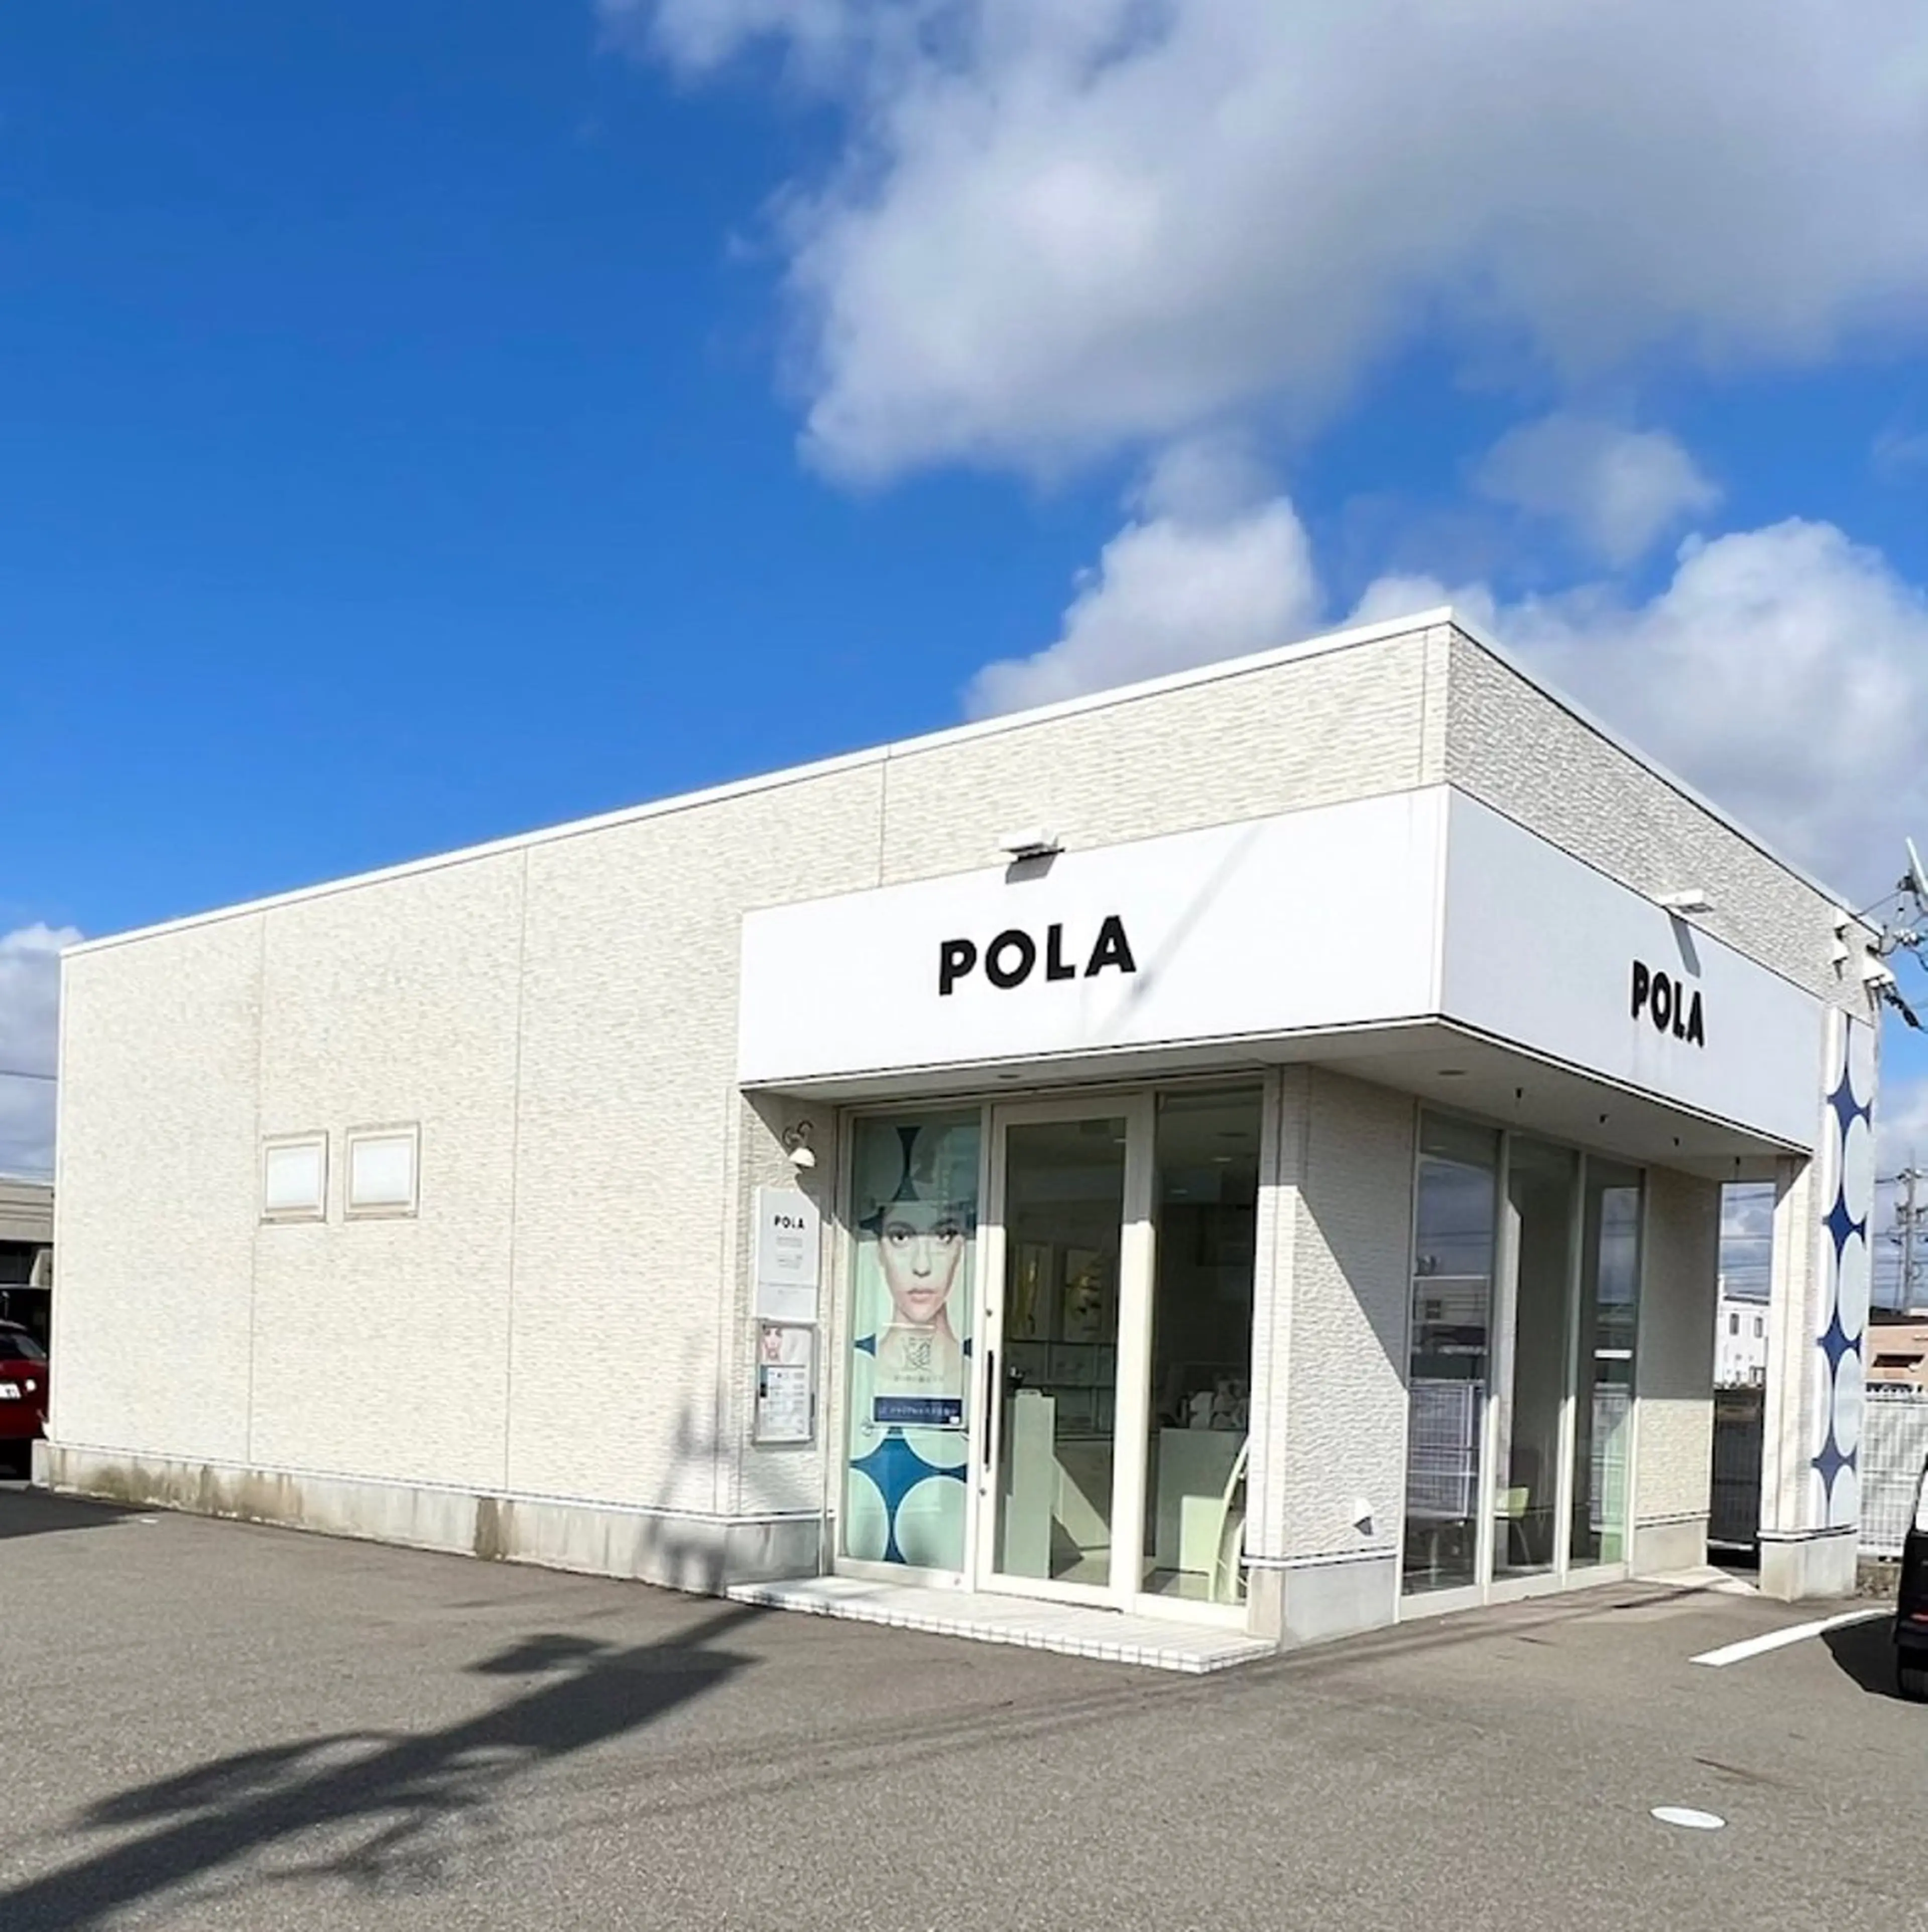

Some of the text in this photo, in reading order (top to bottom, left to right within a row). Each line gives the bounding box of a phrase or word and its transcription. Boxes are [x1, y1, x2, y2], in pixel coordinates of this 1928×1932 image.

[939, 916, 1136, 995] POLA
[1631, 960, 1704, 1048] POLA
[774, 1215, 804, 1229] POLA
